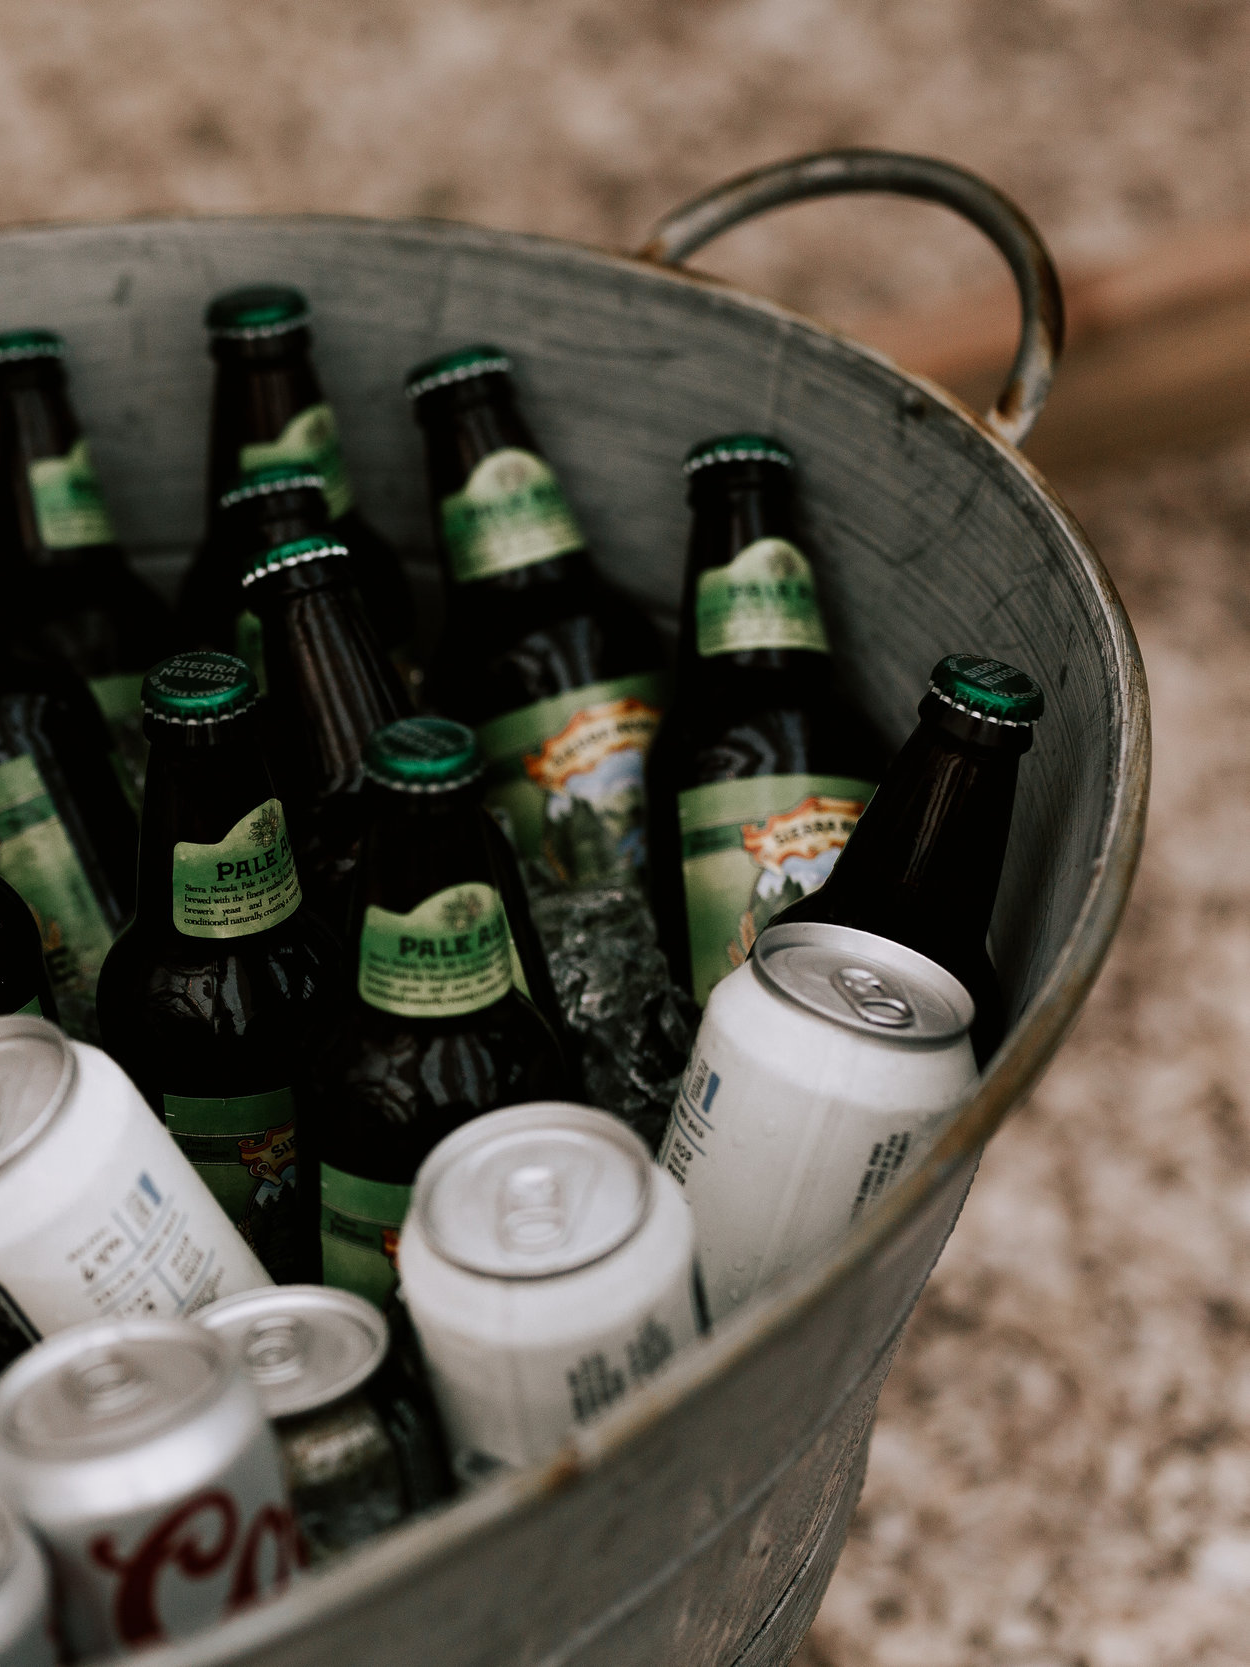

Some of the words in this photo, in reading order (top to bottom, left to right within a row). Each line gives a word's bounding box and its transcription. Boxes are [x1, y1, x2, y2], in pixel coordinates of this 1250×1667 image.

[159, 667, 238, 684] NEVADA
[170, 659, 240, 675] SIERRA
[962, 660, 1004, 679] SIERRA
[977, 668, 1021, 688] NEVADA
[216, 847, 278, 882] PALE
[184, 883, 206, 893] Sierra
[210, 883, 238, 893] Nevada
[241, 879, 256, 890] Pale
[184, 893, 211, 904] brewed
[213, 895, 230, 904] with
[232, 894, 244, 902] the
[246, 889, 264, 900] finest
[184, 904, 214, 915] brewer's
[222, 906, 241, 917] yeast
[248, 899, 262, 910] and
[268, 892, 281, 905] pure
[183, 917, 229, 926] conditioned
[263, 900, 286, 917] creating
[399, 934, 472, 958] PALE
